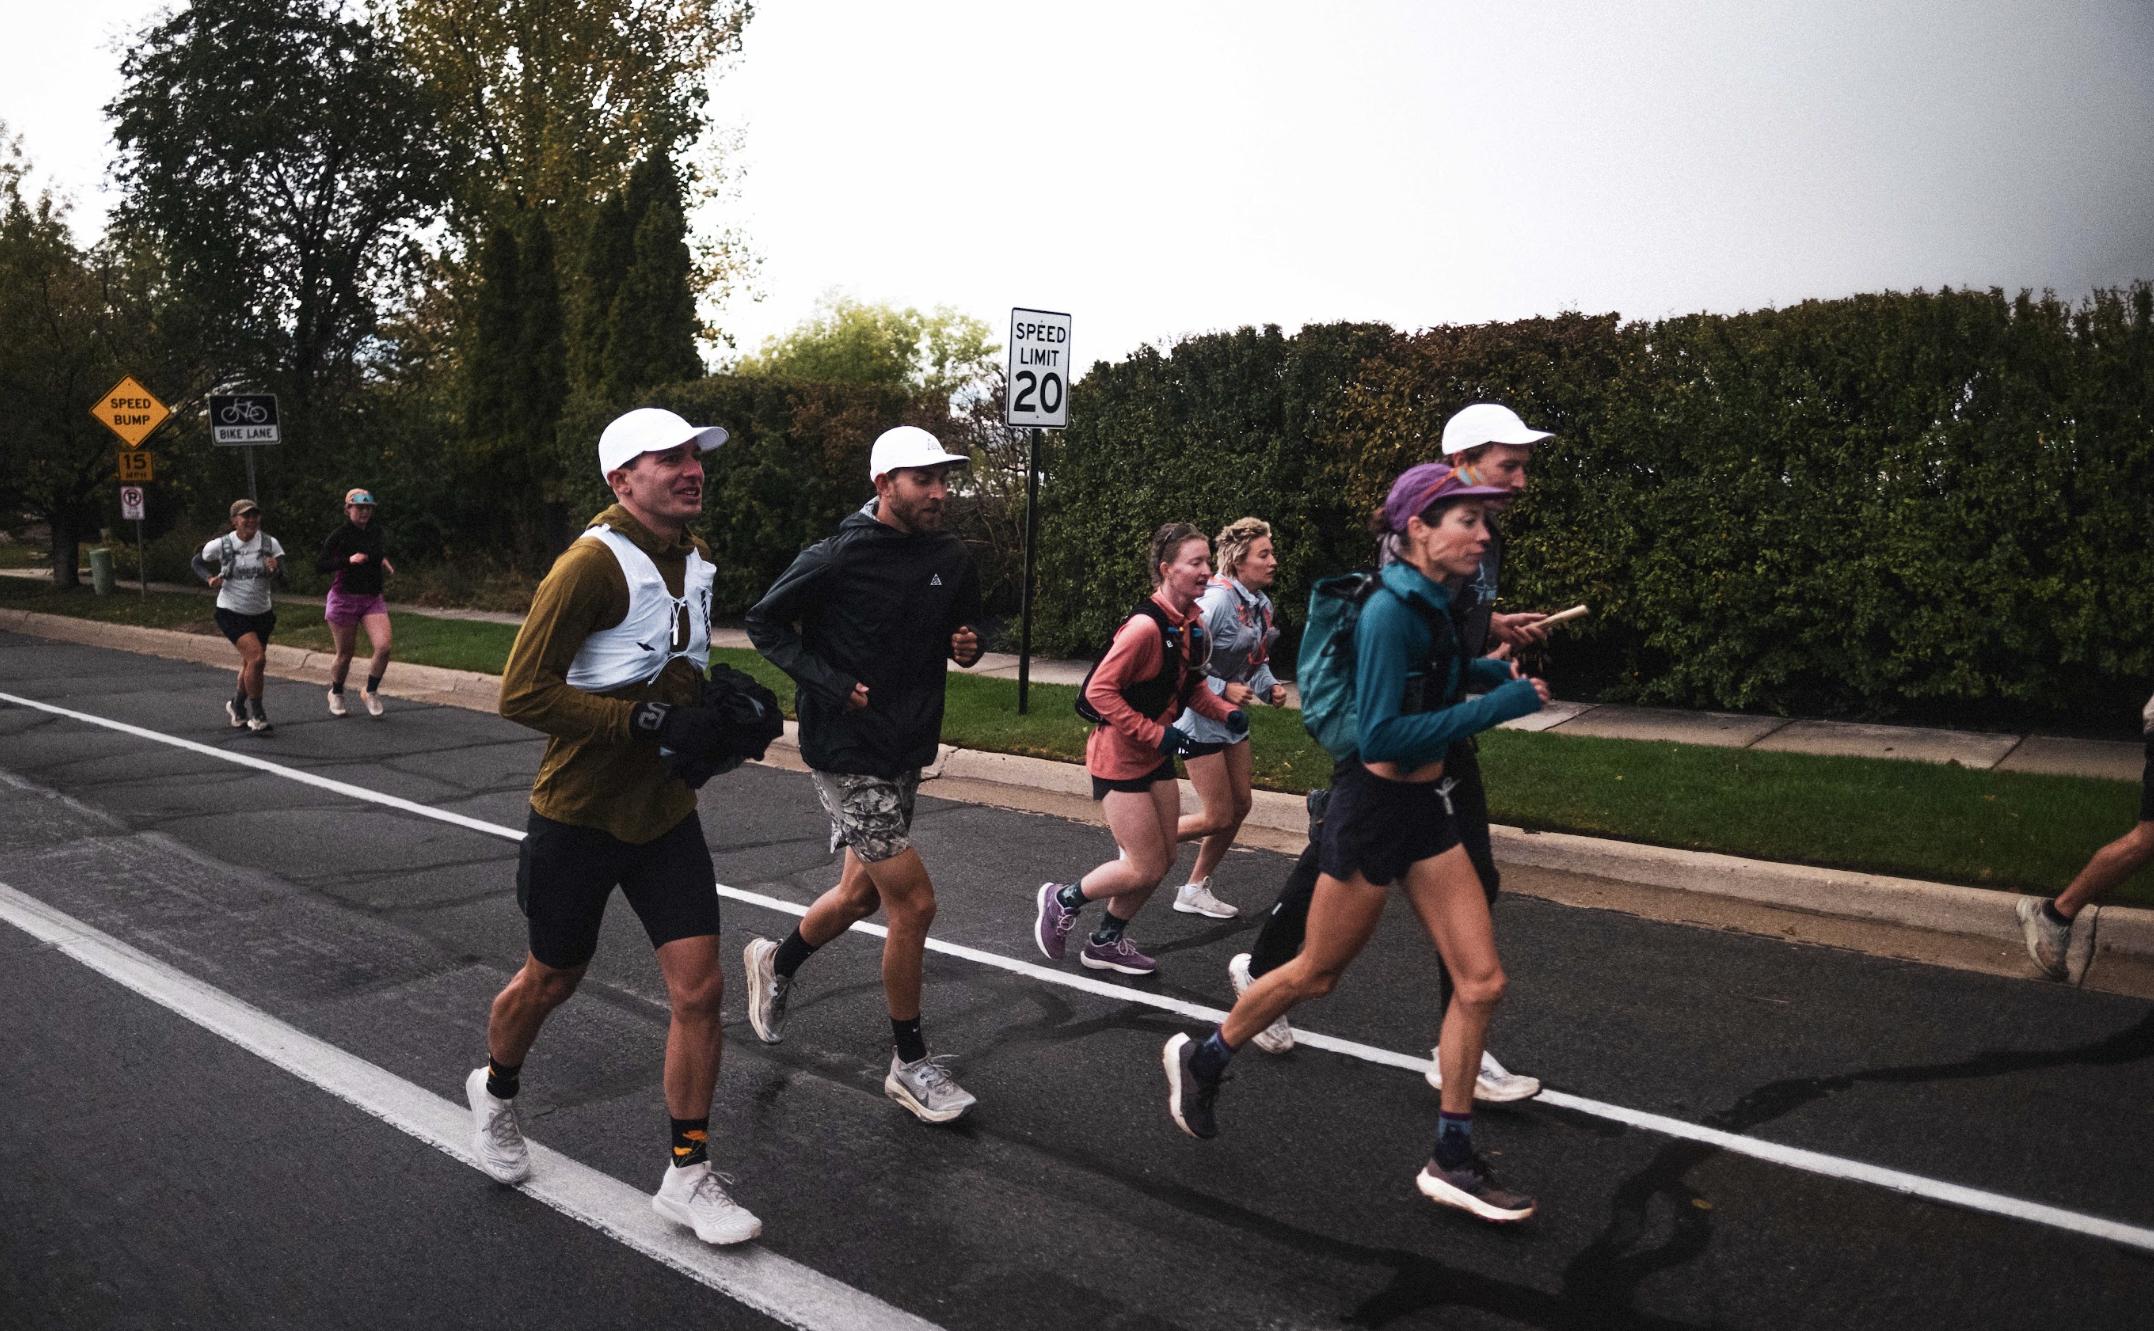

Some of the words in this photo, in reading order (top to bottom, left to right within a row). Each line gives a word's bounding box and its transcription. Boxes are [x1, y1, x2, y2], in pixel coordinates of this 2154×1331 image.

[1016, 322, 1066, 343] SPEED
[1020, 347, 1059, 366] LIMIT
[1013, 370, 1062, 413] 20
[111, 398, 151, 409] SPEED
[114, 414, 150, 425] BUMP
[220, 429, 243, 440] BIKE
[247, 427, 273, 439] LANE
[124, 454, 146, 469] 15
